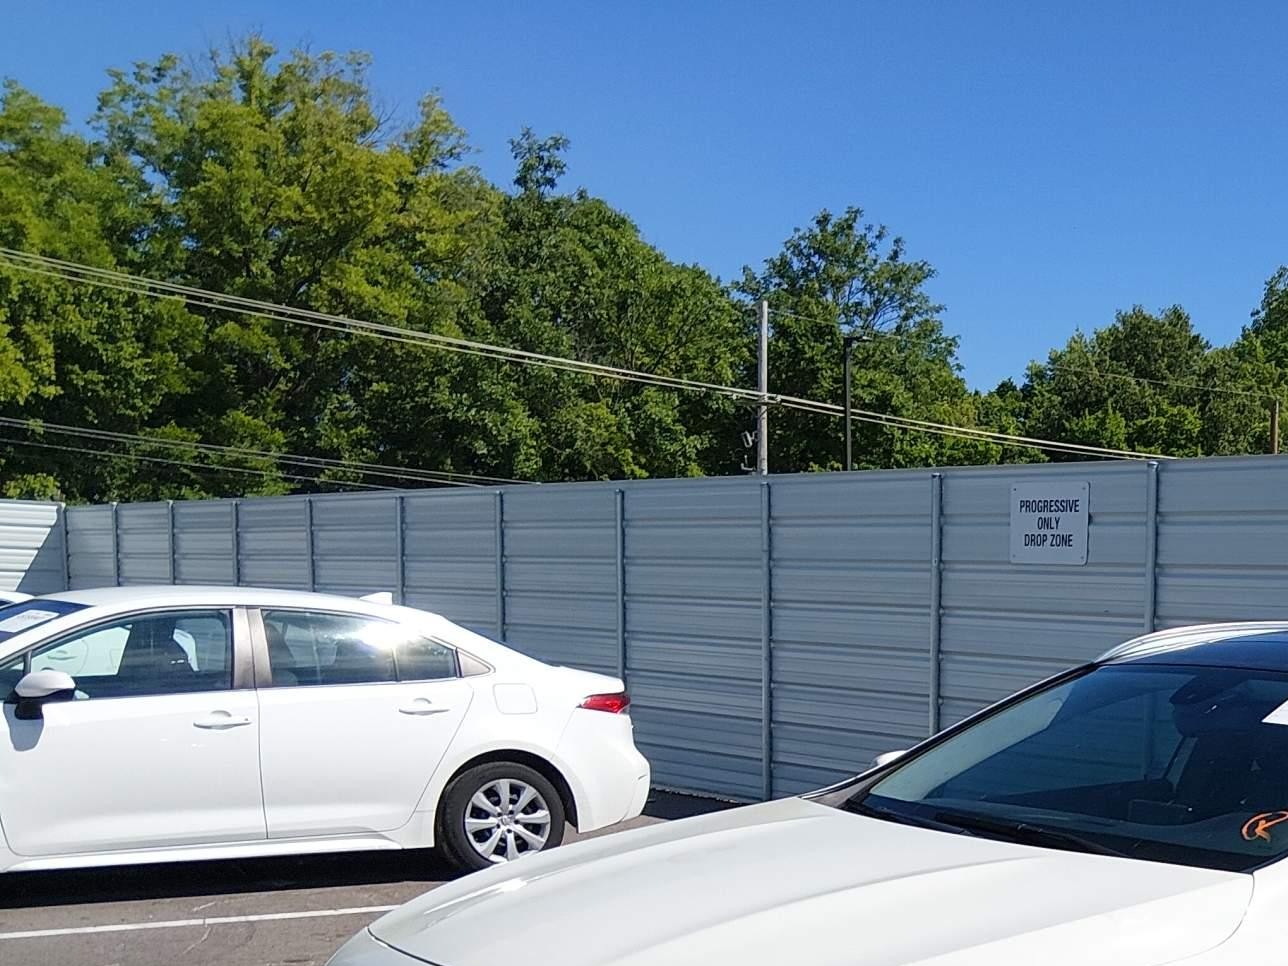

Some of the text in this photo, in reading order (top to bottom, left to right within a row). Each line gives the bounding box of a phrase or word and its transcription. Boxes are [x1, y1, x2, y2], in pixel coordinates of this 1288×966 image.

[1019, 499, 1080, 513] PROGRESSIVE
[1037, 516, 1060, 530] ONLY
[1024, 533, 1073, 547] DROP ZONE
